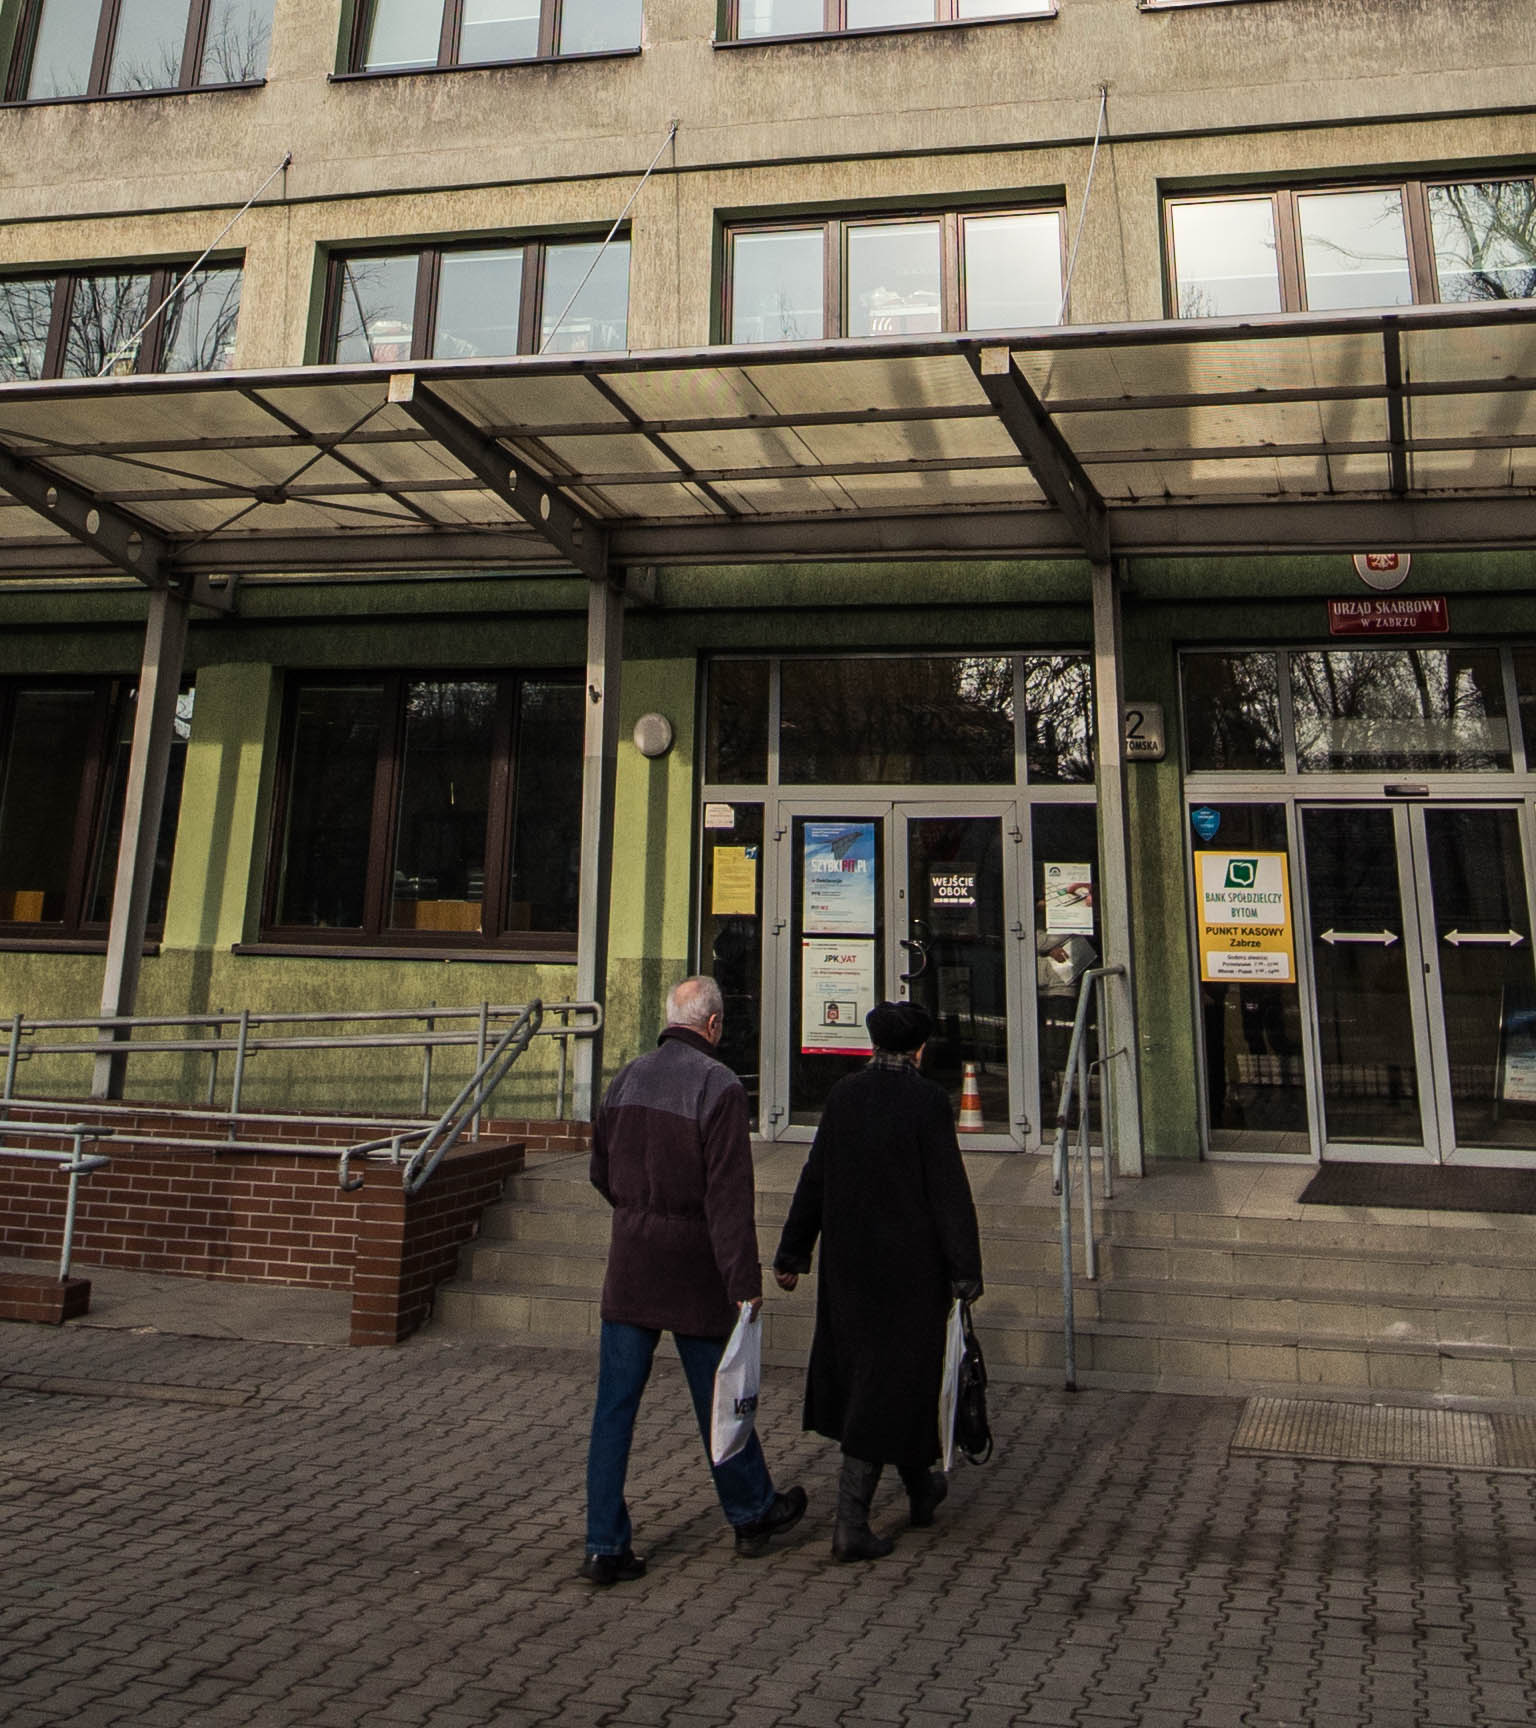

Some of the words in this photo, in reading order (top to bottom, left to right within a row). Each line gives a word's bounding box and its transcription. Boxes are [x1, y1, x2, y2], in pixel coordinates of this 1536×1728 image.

[1333, 602, 1371, 616] URZĄD
[1375, 600, 1441, 614] SKARBOWY
[1360, 618, 1370, 627] W
[1375, 617, 1417, 628] ZABRZU
[1126, 711, 1145, 739] 2
[932, 874, 974, 887] WEJŚCIE
[938, 886, 968, 897] OBOK
[1205, 892, 1226, 903] BANK
[1228, 891, 1283, 904] SPÓŁDZIELCZY
[1231, 907, 1258, 918] BYTOM
[1205, 926, 1239, 936] PUNKT
[1241, 927, 1284, 937] KASOWY
[1230, 939, 1261, 947] Zabrze
